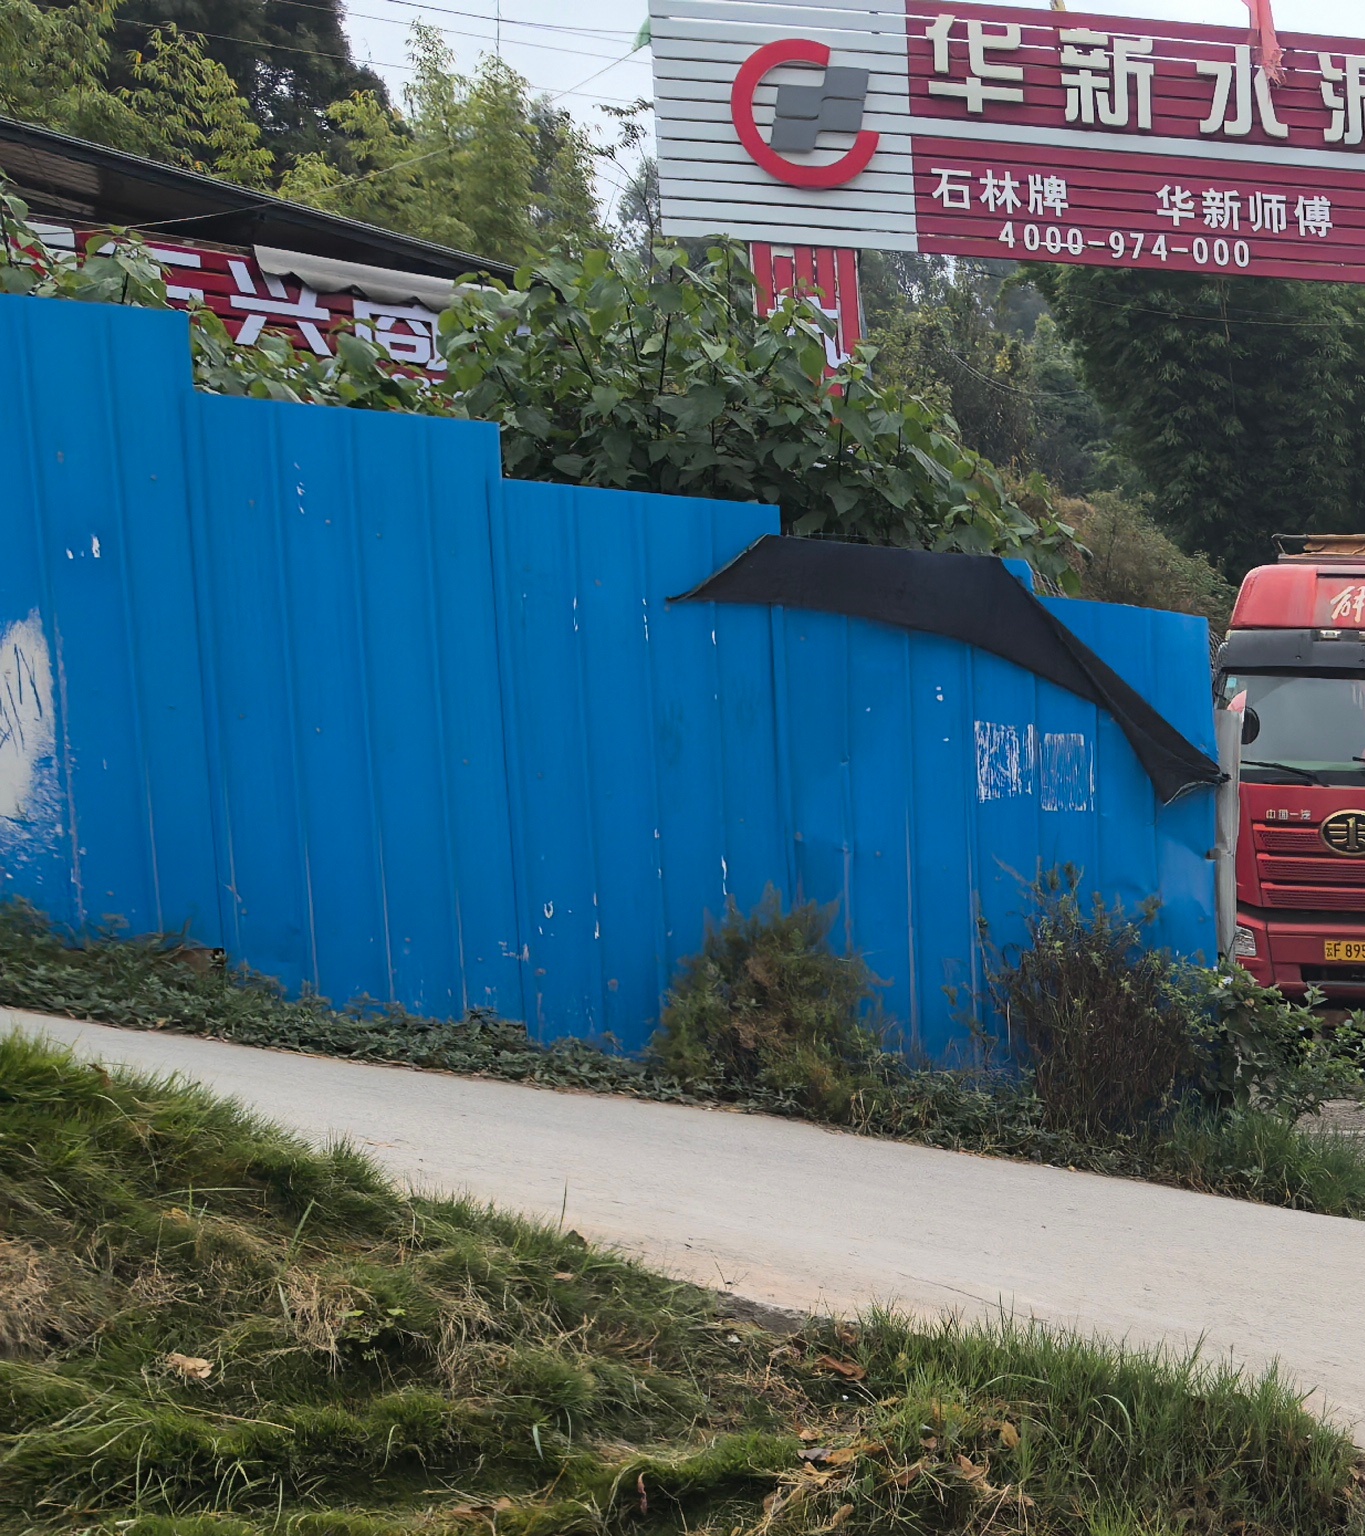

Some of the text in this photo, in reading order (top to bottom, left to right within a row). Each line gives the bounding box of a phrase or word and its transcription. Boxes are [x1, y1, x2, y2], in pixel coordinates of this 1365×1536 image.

[930, 167, 1333, 238] 石林牌 华新师傅
[998, 221, 1251, 268] 4000-974-000
